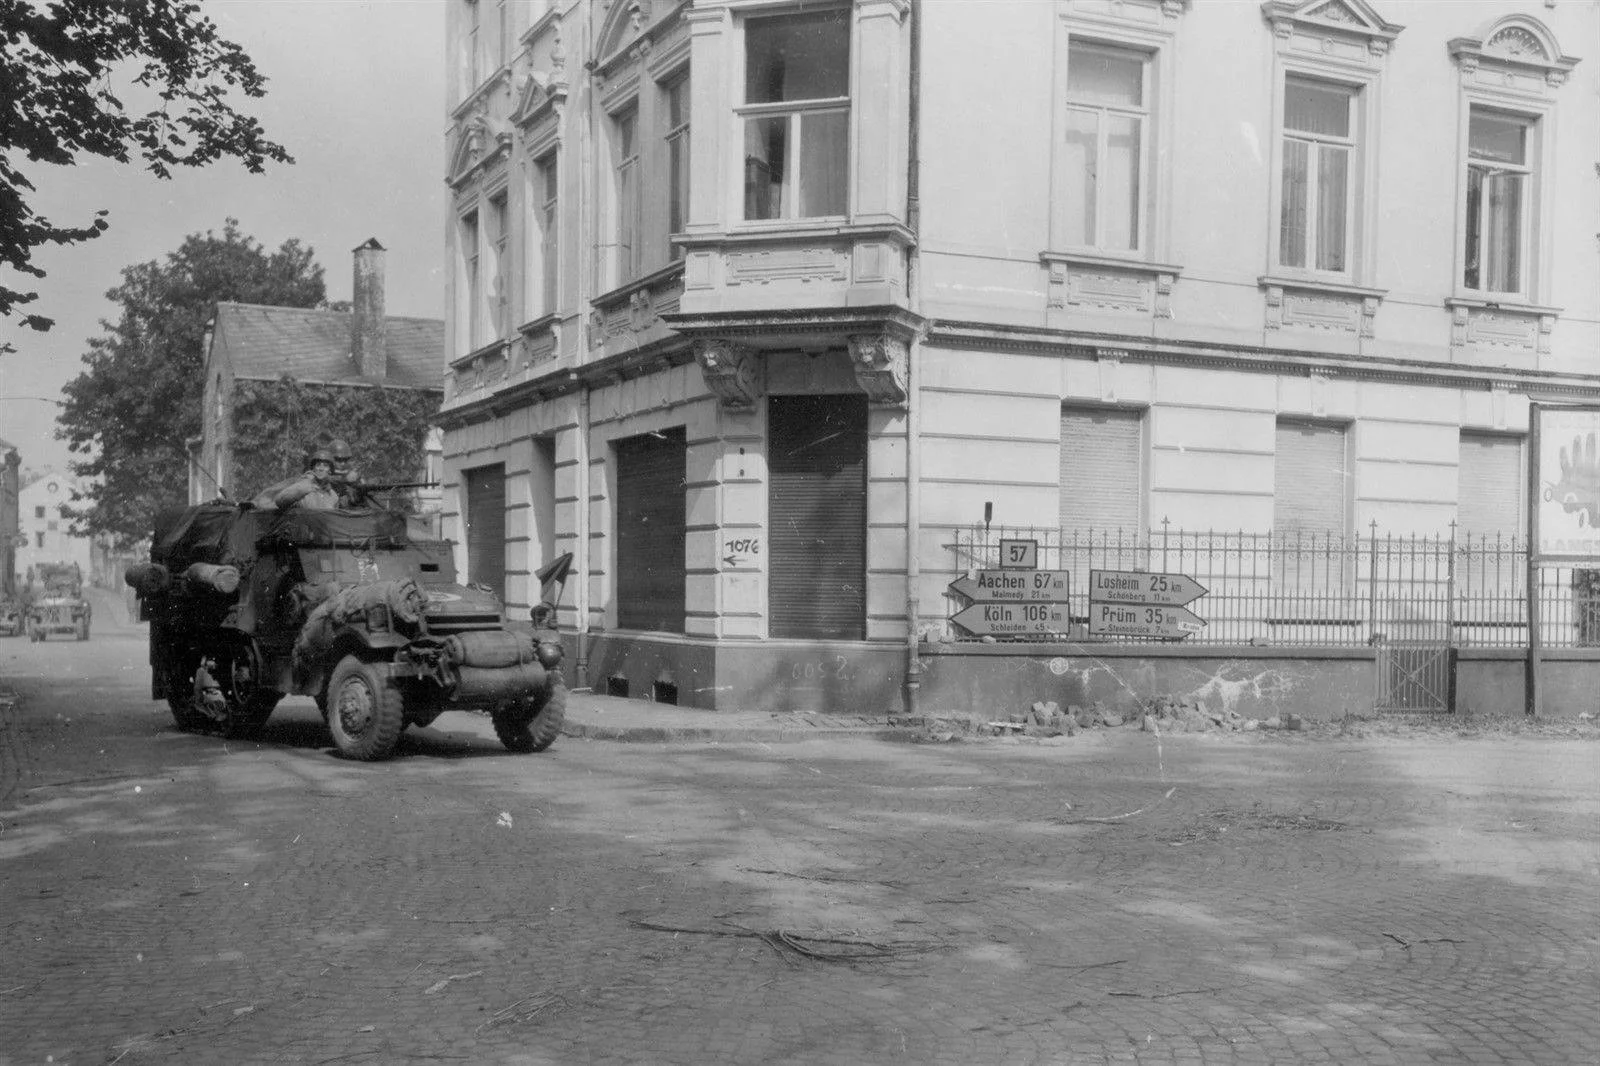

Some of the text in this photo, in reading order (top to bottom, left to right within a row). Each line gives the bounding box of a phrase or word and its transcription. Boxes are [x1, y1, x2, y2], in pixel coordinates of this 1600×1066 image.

[725, 539, 759, 554] 1076
[1010, 546, 1027, 563] 57
[978, 573, 1064, 589] Aachen 67 km
[1097, 573, 1182, 593] Losheim 25 km
[992, 591, 1025, 600] Malmedy
[1108, 591, 1146, 602] Schönberg
[984, 605, 1062, 621] Köln 106 km
[1102, 606, 1177, 624] Prüm 35 km
[990, 623, 1027, 632] Schleiden
